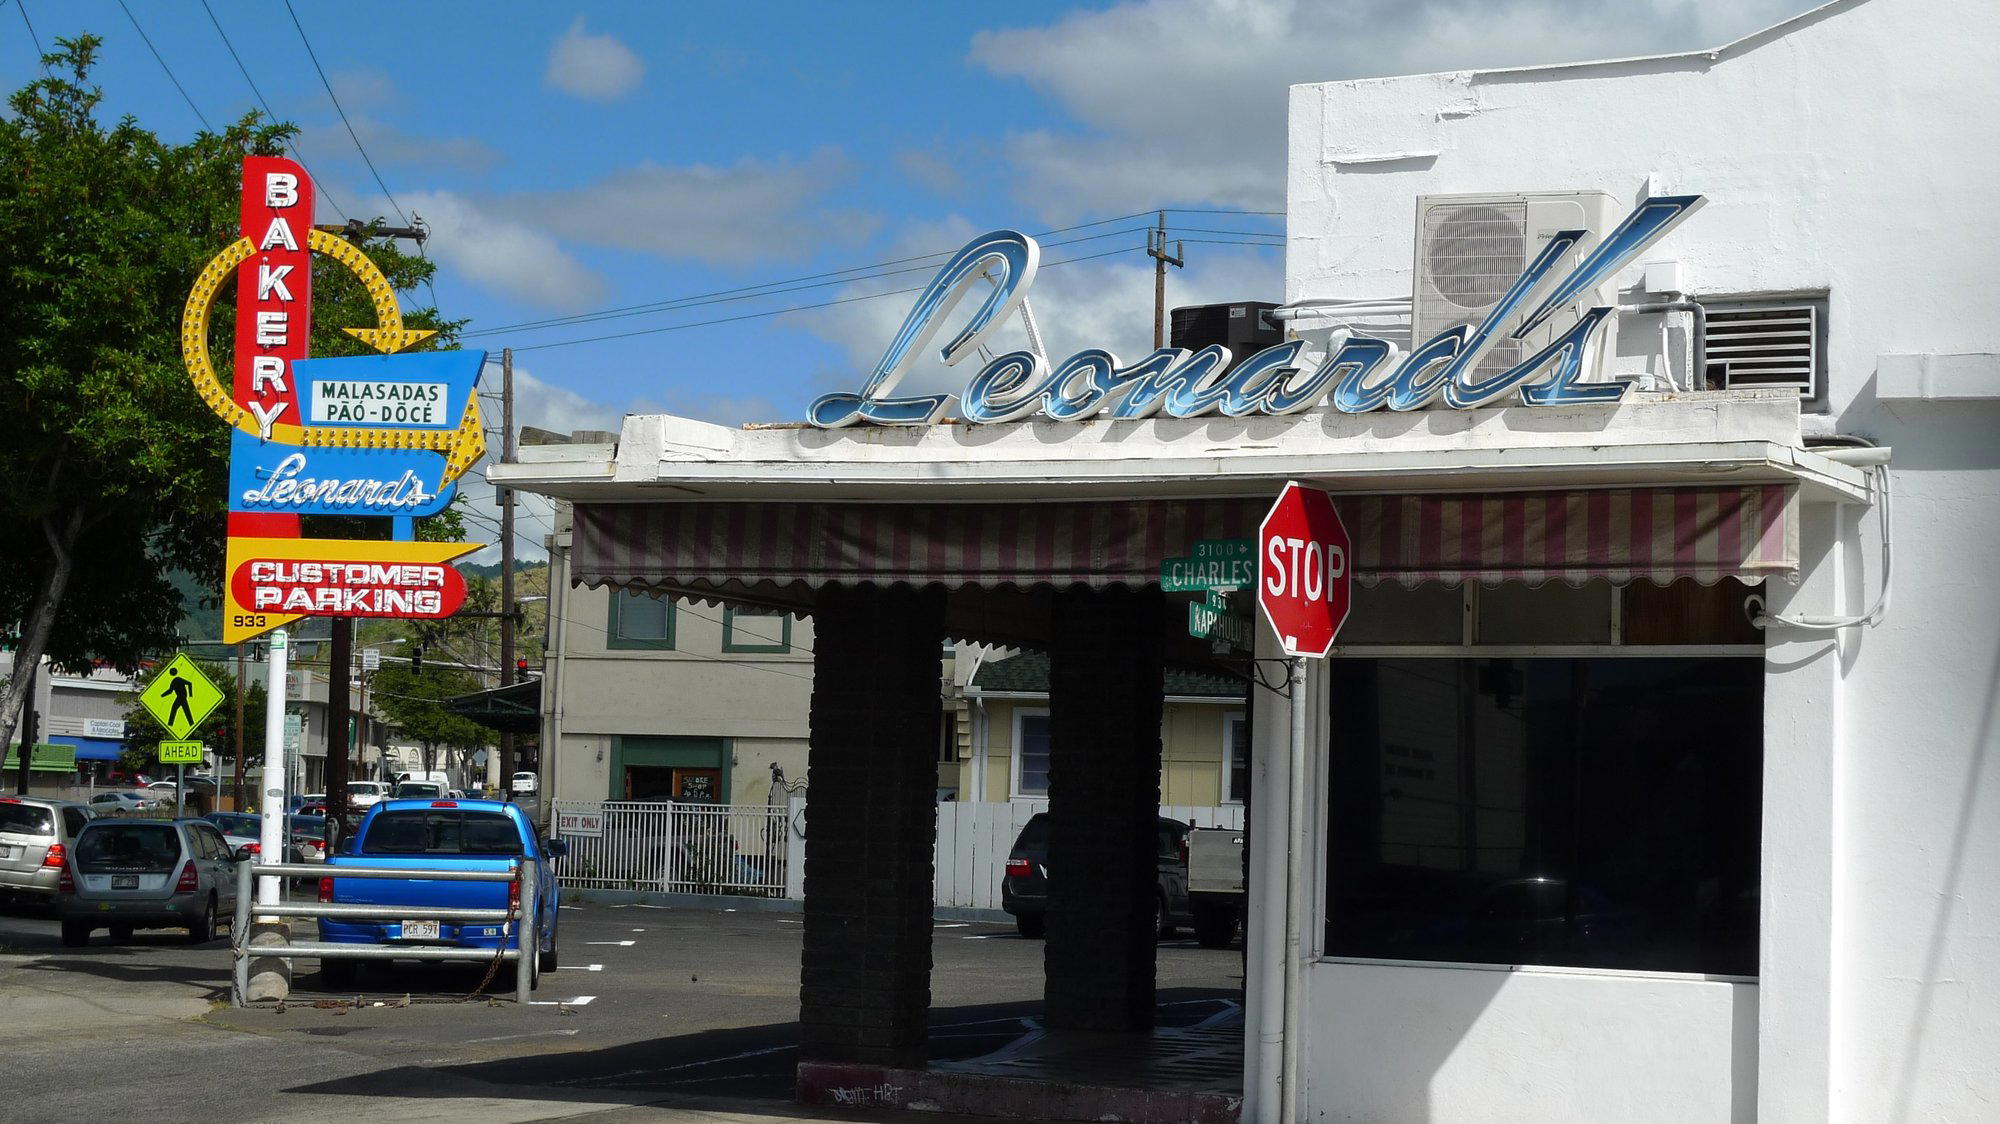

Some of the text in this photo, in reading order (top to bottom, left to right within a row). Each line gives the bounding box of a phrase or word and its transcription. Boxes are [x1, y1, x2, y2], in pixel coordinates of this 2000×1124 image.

[248, 172, 299, 440] BAKERY
[322, 382, 439, 401] MALASADAS
[1198, 543, 1233, 557] 3100
[250, 562, 445, 587] CUSTOMER
[1172, 560, 1253, 587] CHARLES
[1266, 535, 1346, 603] STOP
[255, 586, 442, 613] PARKING
[233, 615, 266, 627] 933
[1193, 604, 1242, 642] KAPAHULU
[164, 745, 198, 758] AHEAD
[561, 816, 600, 829] EXIT ONLY
[403, 923, 438, 935] PCR 597
